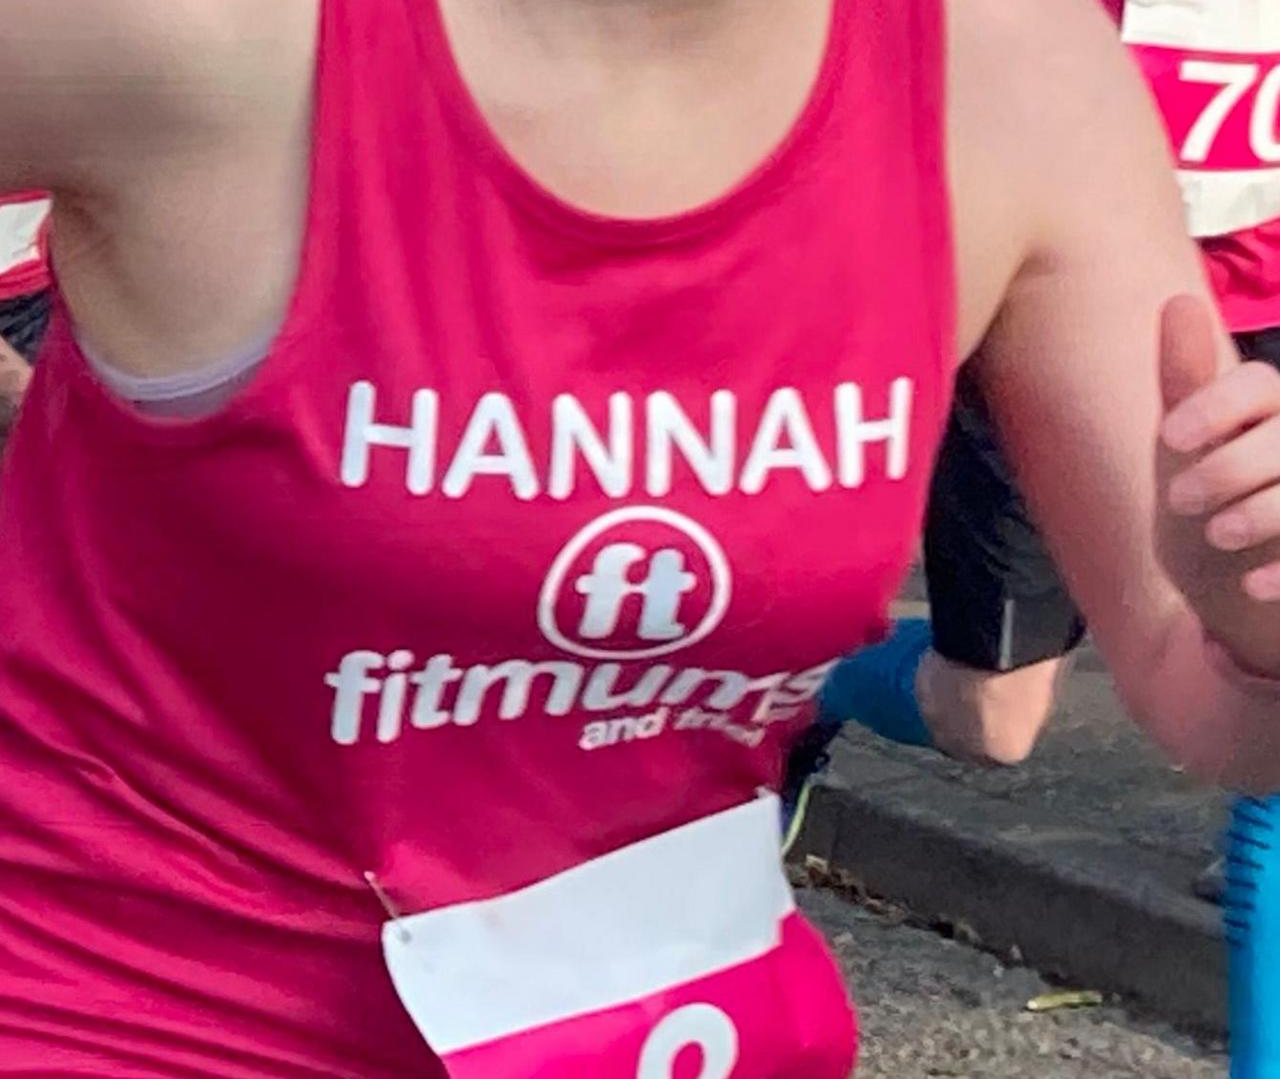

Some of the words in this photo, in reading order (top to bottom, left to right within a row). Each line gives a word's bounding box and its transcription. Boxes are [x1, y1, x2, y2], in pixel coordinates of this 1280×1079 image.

[341, 376, 913, 500] HANNAH
[575, 543, 697, 640] ft
[578, 706, 671, 750] and
